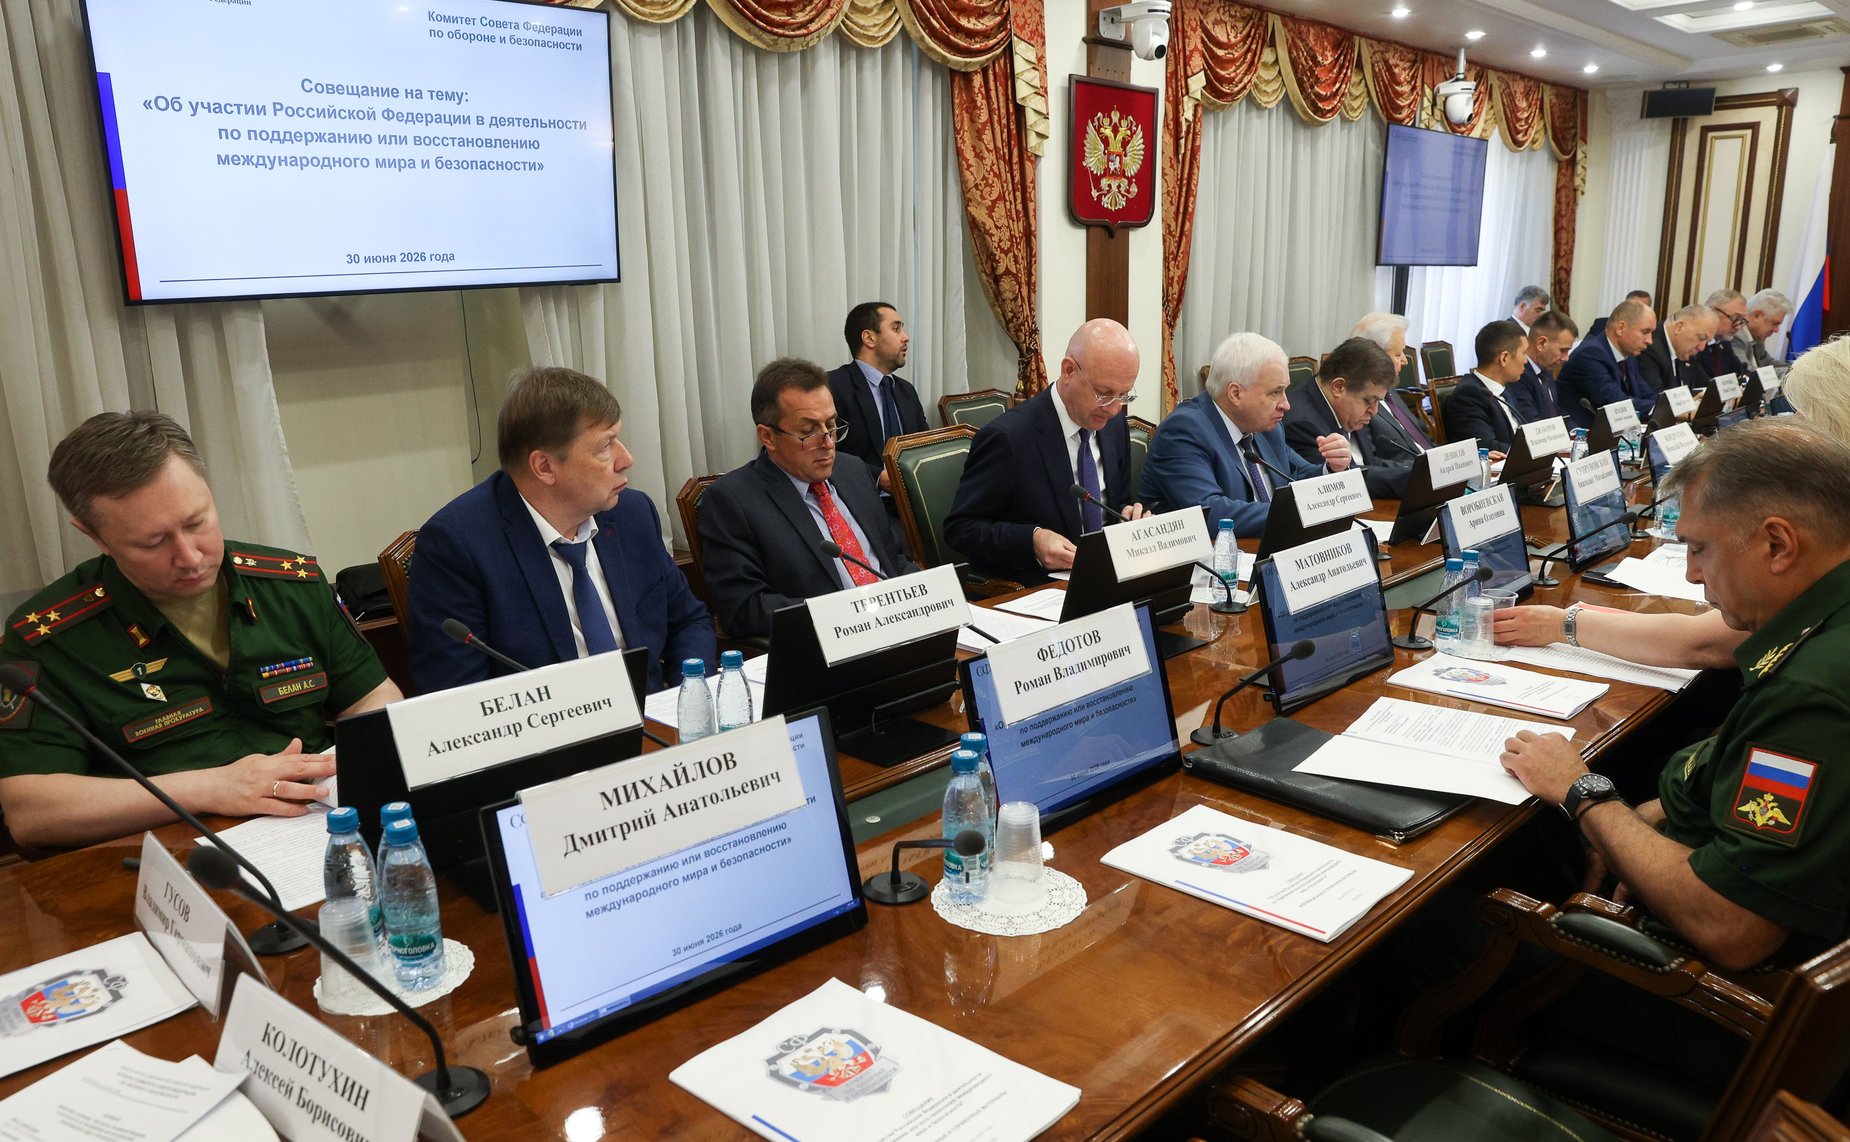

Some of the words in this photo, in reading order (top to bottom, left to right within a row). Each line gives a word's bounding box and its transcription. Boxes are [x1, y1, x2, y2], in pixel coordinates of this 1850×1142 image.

[428, 11, 476, 26] Комитет
[480, 16, 520, 30] Совета
[523, 21, 582, 37] Федерации
[429, 28, 444, 38] по
[447, 30, 496, 43] обороне
[500, 36, 506, 44] и
[509, 35, 582, 51] безопасности
[300, 78, 400, 99] Совещание
[404, 88, 423, 100] на
[427, 89, 469, 105] тему:
[142, 95, 183, 112] «Об
[188, 100, 267, 117] участии
[272, 101, 377, 121] Российской
[381, 108, 471, 127] Федерации
[476, 115, 485, 126] в
[489, 115, 587, 131] деятельности
[218, 127, 242, 140] по
[247, 128, 373, 146] поддержанию
[377, 133, 408, 146] или
[413, 135, 540, 150] восстановлению
[216, 153, 370, 170] международного
[375, 157, 417, 172] мира
[420, 158, 430, 169] и
[434, 156, 545, 172] безопасности»
[346, 253, 360, 265] 30
[363, 253, 396, 266] июня
[400, 250, 426, 263] 2026
[429, 250, 456, 265] года
[1307, 498, 1336, 511] Александр
[1335, 492, 1362, 505] Сергеевич
[1317, 481, 1346, 495] АЛИМОВ
[1131, 519, 1185, 542] АГАСАНДЯН
[1469, 516, 1484, 530] Арина
[1484, 509, 1505, 523] Олеговна
[1126, 545, 1157, 559] Микаэл
[1157, 534, 1197, 551] Вадимович
[1294, 542, 1353, 572] МАТОВНИКОВ
[1290, 572, 1327, 592] Александр
[1327, 557, 1368, 579] Анатольевич
[850, 583, 928, 614] ТЕРЕНТЬЕВ
[833, 620, 872, 639] Роман
[874, 598, 956, 629] Александрович
[1036, 629, 1102, 662] ФЕДОТОВ
[136, 666, 143, 676] 1
[1014, 675, 1052, 695] Роман
[1053, 645, 1132, 682] Владимирович
[277, 682, 302, 696] БЕЛАН
[303, 679, 316, 690] А.С.
[479, 684, 553, 718] БЕЛАН
[135, 723, 163, 737] ВОЕННАЯ
[164, 706, 204, 726] ПРОКУРАТУРА
[155, 710, 182, 724] ГЛАВНАЯ
[1019, 725, 1029, 736] по
[1029, 709, 1073, 732] поддержанию
[1073, 703, 1086, 716] или
[1086, 685, 1134, 710] восстановлению
[1020, 722, 1074, 748] международного
[1074, 714, 1090, 728] мира
[1095, 697, 1137, 719] безопасности»
[426, 720, 523, 758] Александр
[527, 697, 613, 730] Сергеевич
[599, 750, 738, 812] МИХАЙЛОВ
[562, 809, 657, 859] Дмитрий
[663, 769, 782, 823] Анатольевич
[584, 890, 599, 902] по
[602, 861, 680, 896] поддержанию
[682, 853, 702, 867] или
[704, 821, 787, 858] восстановлению
[585, 877, 680, 920] международного
[682, 868, 709, 883] мира
[711, 864, 718, 873] и
[720, 836, 793, 869] безопасности»
[142, 884, 169, 933] Владимир
[163, 882, 191, 923] ГУСОВ
[672, 946, 682, 957] 30
[683, 940, 705, 952] июня
[706, 929, 724, 943] 2026
[725, 922, 743, 936] года
[262, 1022, 371, 1112] КОЛОТУХИН
[241, 1049, 295, 1100] Алексей
[296, 1086, 371, 1142] Борисови
